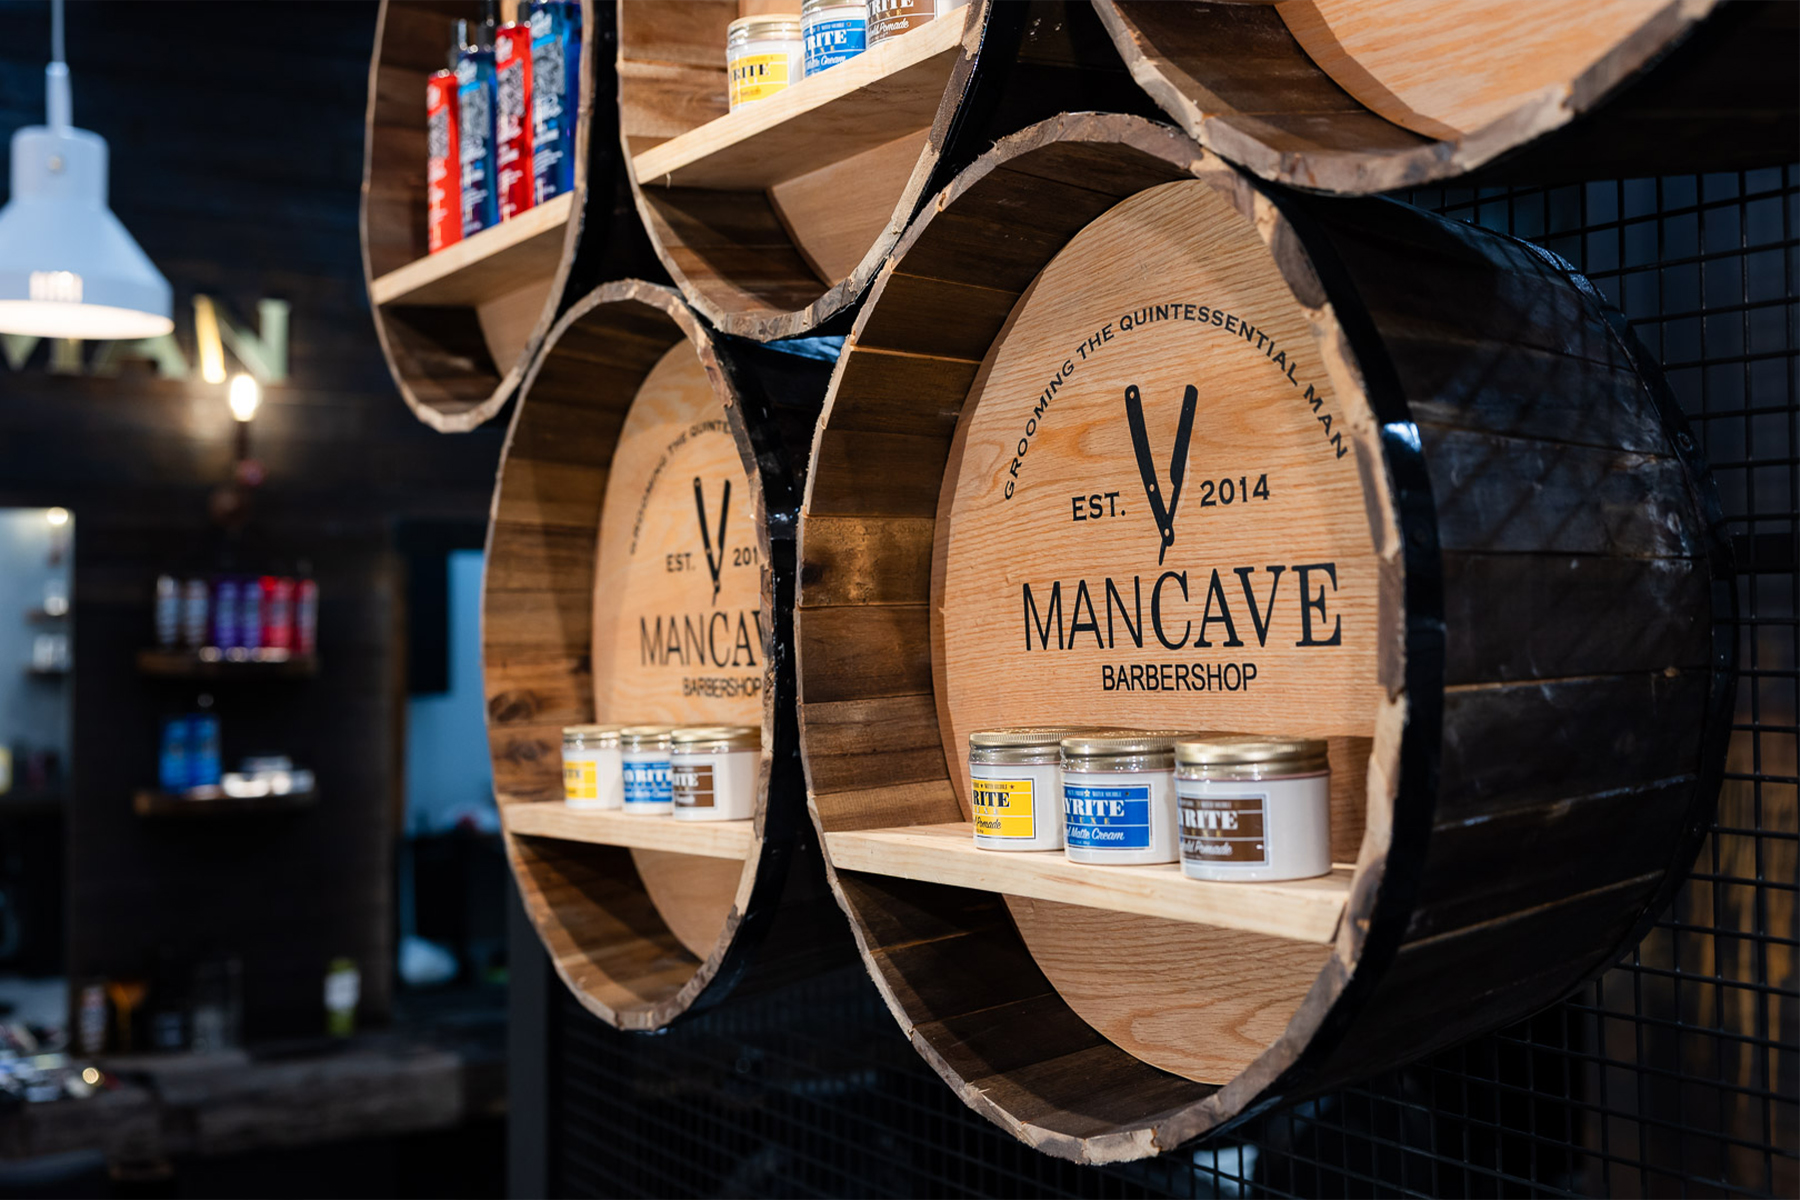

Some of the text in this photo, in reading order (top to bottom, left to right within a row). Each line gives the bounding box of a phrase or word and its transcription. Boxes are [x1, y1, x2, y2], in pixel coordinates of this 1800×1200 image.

[1004, 303, 1348, 500] GROOMING THE QUINTESSENTIAL MAN
[1071, 473, 1270, 521] EST. 2014
[666, 552, 696, 573] EST.
[1022, 562, 1342, 651] MANCAVE
[683, 676, 762, 698] BARBERSHOP
[1101, 663, 1258, 691] BARBERSHOP
[973, 790, 1010, 808] RITE
[1091, 827, 1126, 841] Cream
